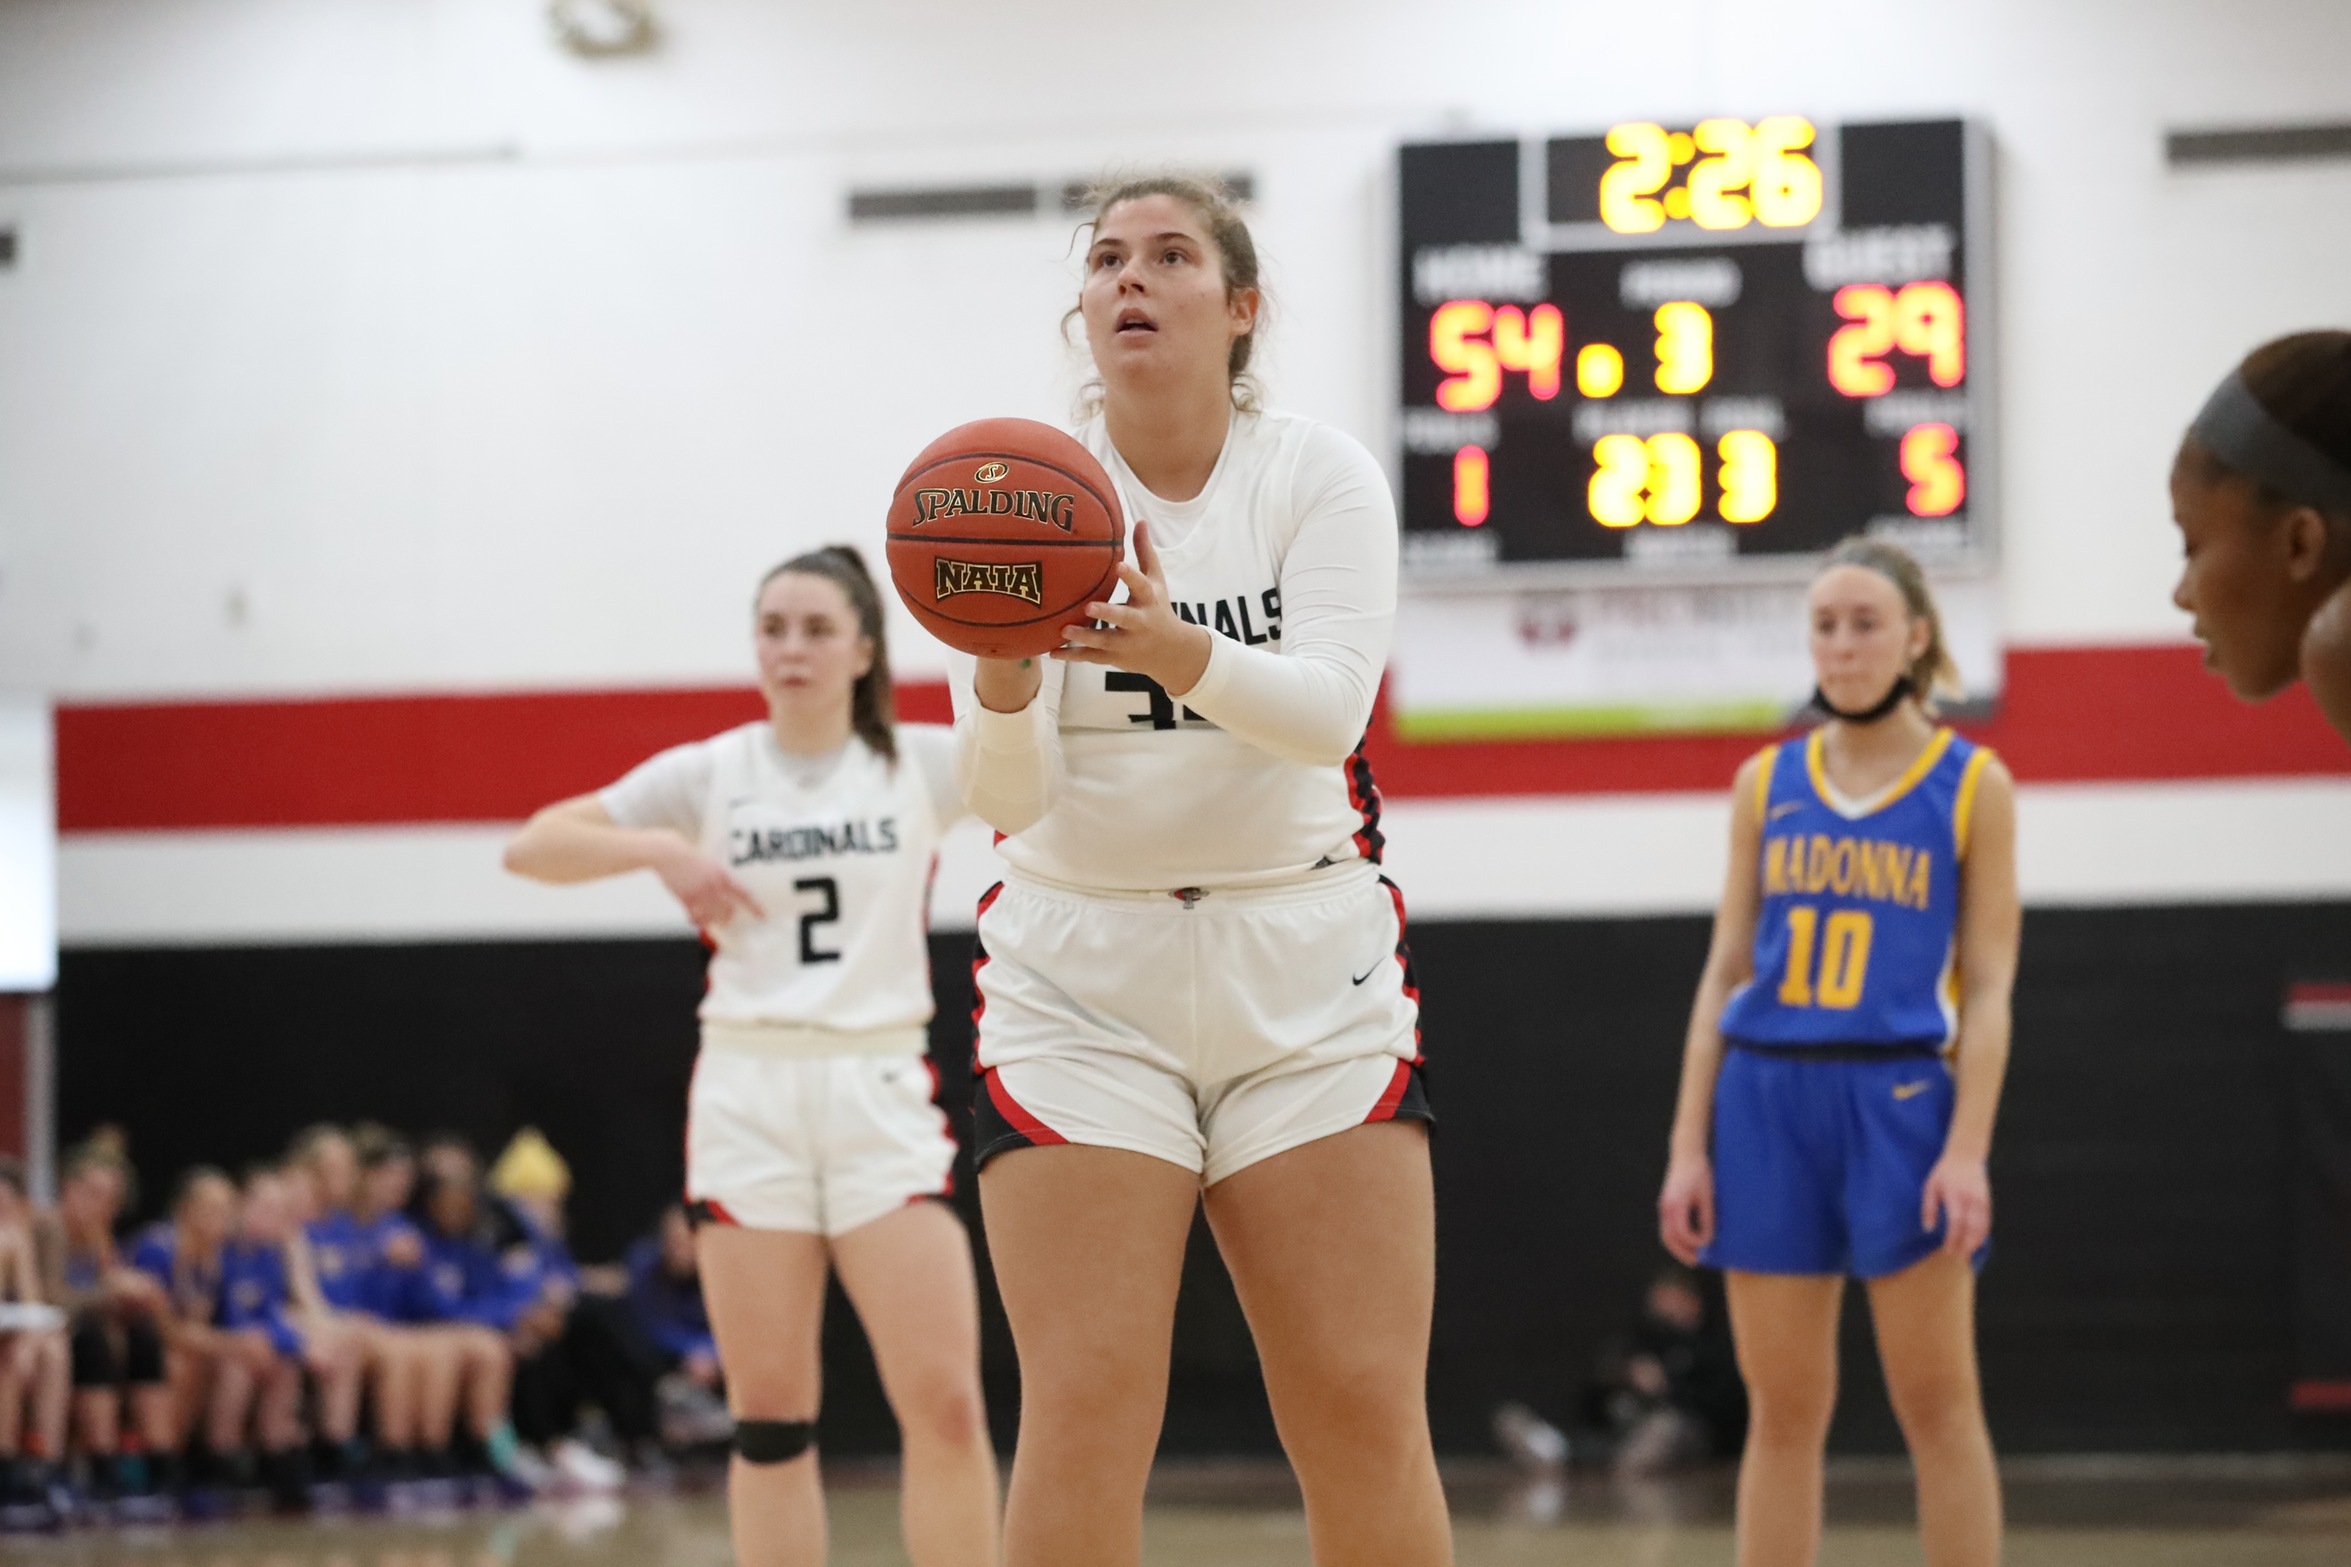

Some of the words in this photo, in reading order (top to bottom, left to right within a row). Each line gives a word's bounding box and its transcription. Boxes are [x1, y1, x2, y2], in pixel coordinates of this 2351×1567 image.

[1600, 116, 1822, 232] 2:26
[1430, 301, 1562, 411] 54
[1654, 302, 1713, 394] 3
[1828, 282, 1964, 397] 29
[912, 487, 1075, 535] SPALDING
[1454, 446, 1489, 526] 1
[1717, 430, 1777, 523] 3
[1900, 424, 1964, 517] 5
[936, 558, 1041, 605] NAIA
[732, 819, 897, 866] CARDINALS
[1766, 834, 1930, 911] MADONNA
[794, 877, 841, 964] 2
[1778, 906, 1873, 1009] 10
